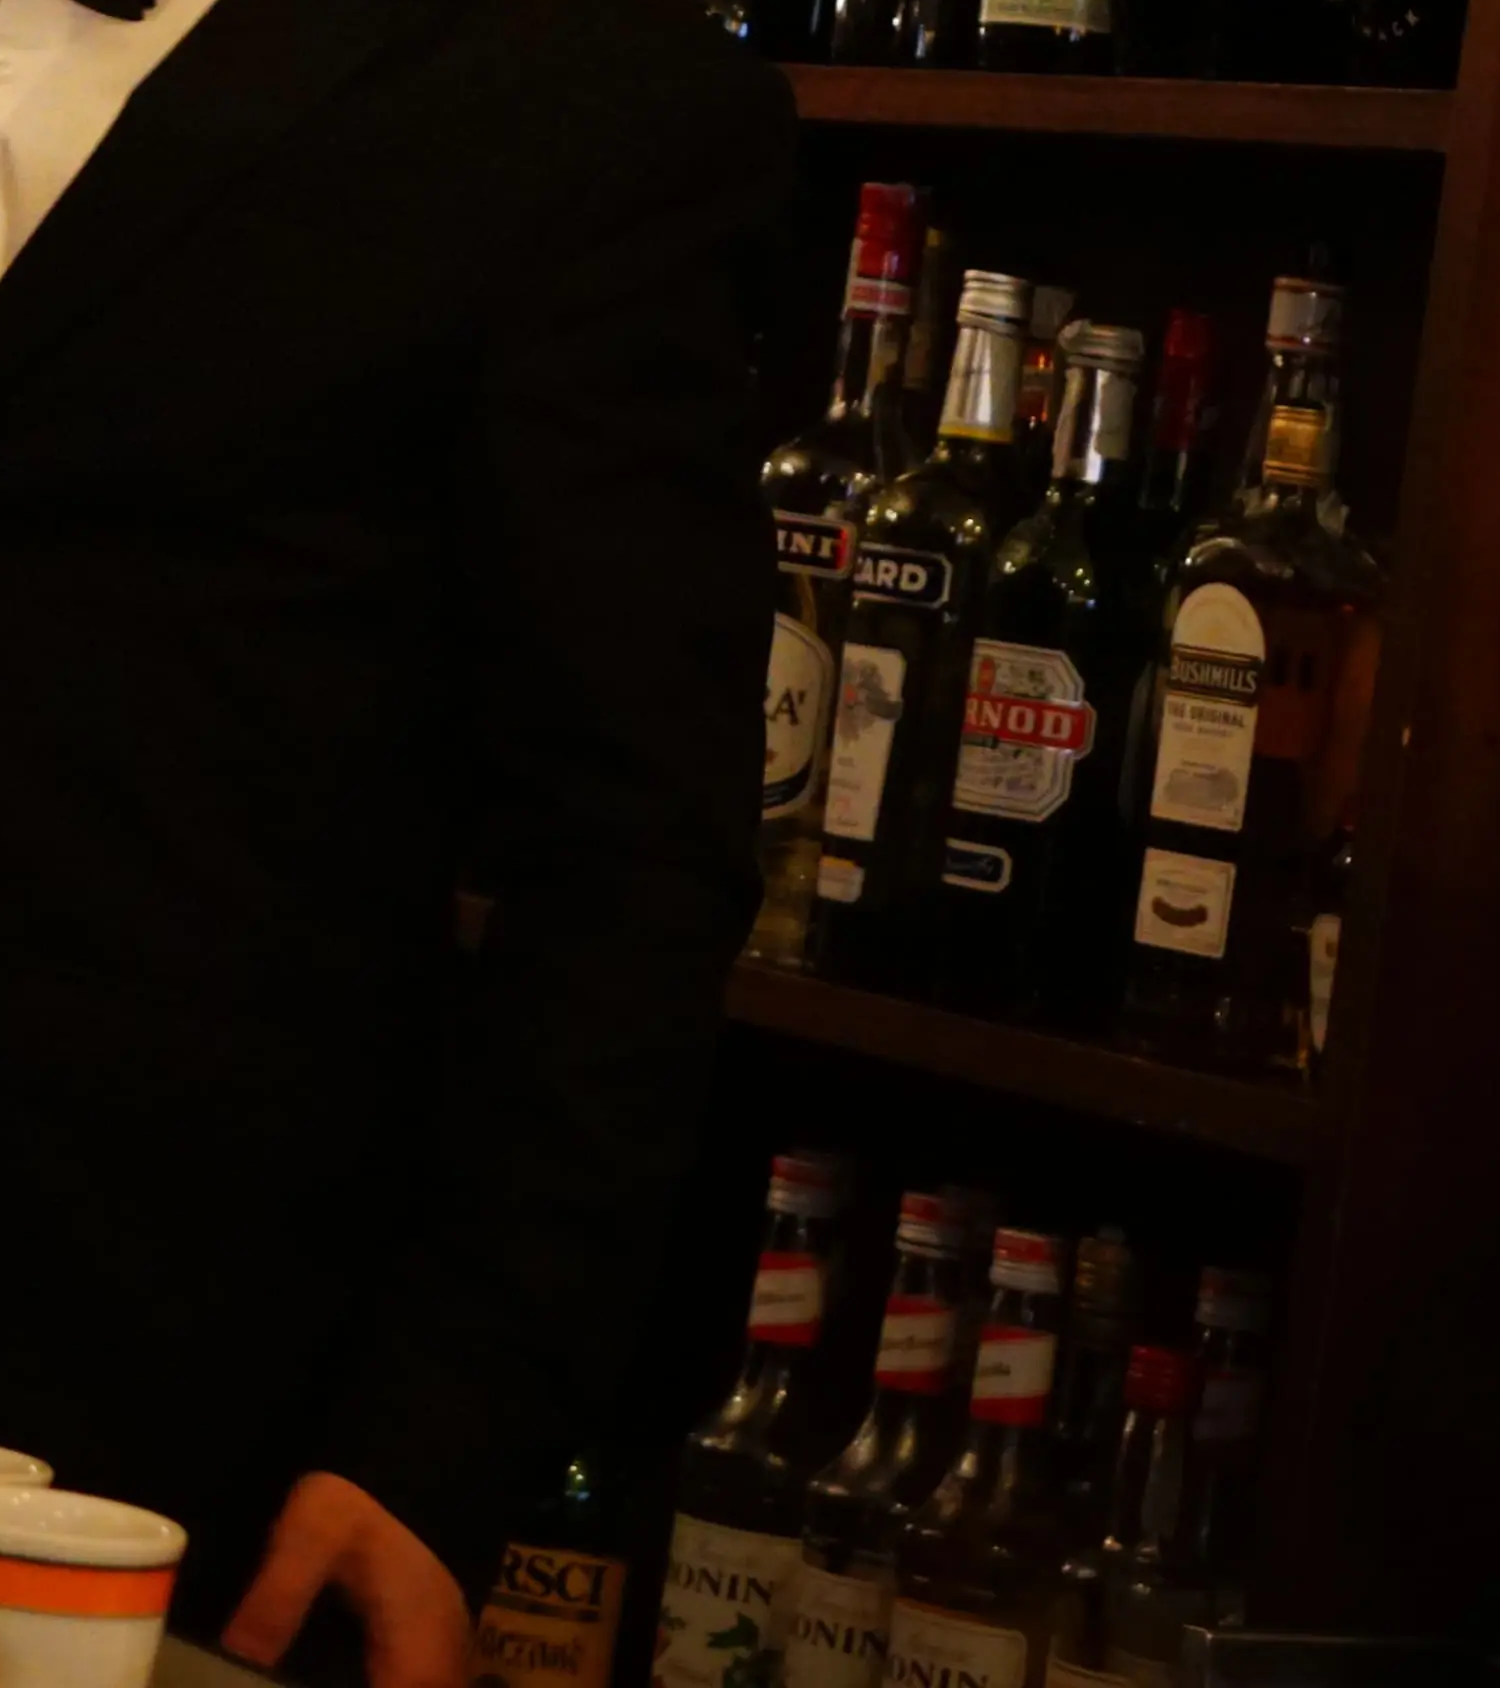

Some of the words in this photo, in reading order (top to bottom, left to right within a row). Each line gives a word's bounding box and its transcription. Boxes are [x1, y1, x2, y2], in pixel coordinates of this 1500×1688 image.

[852, 555, 929, 594] ARD
[1170, 656, 1259, 695] BUSHMILLS
[964, 696, 1074, 742] RNOD
[502, 1548, 607, 1606] RSCI
[672, 1563, 775, 1607] ONIN
[788, 1614, 889, 1660] ONIN
